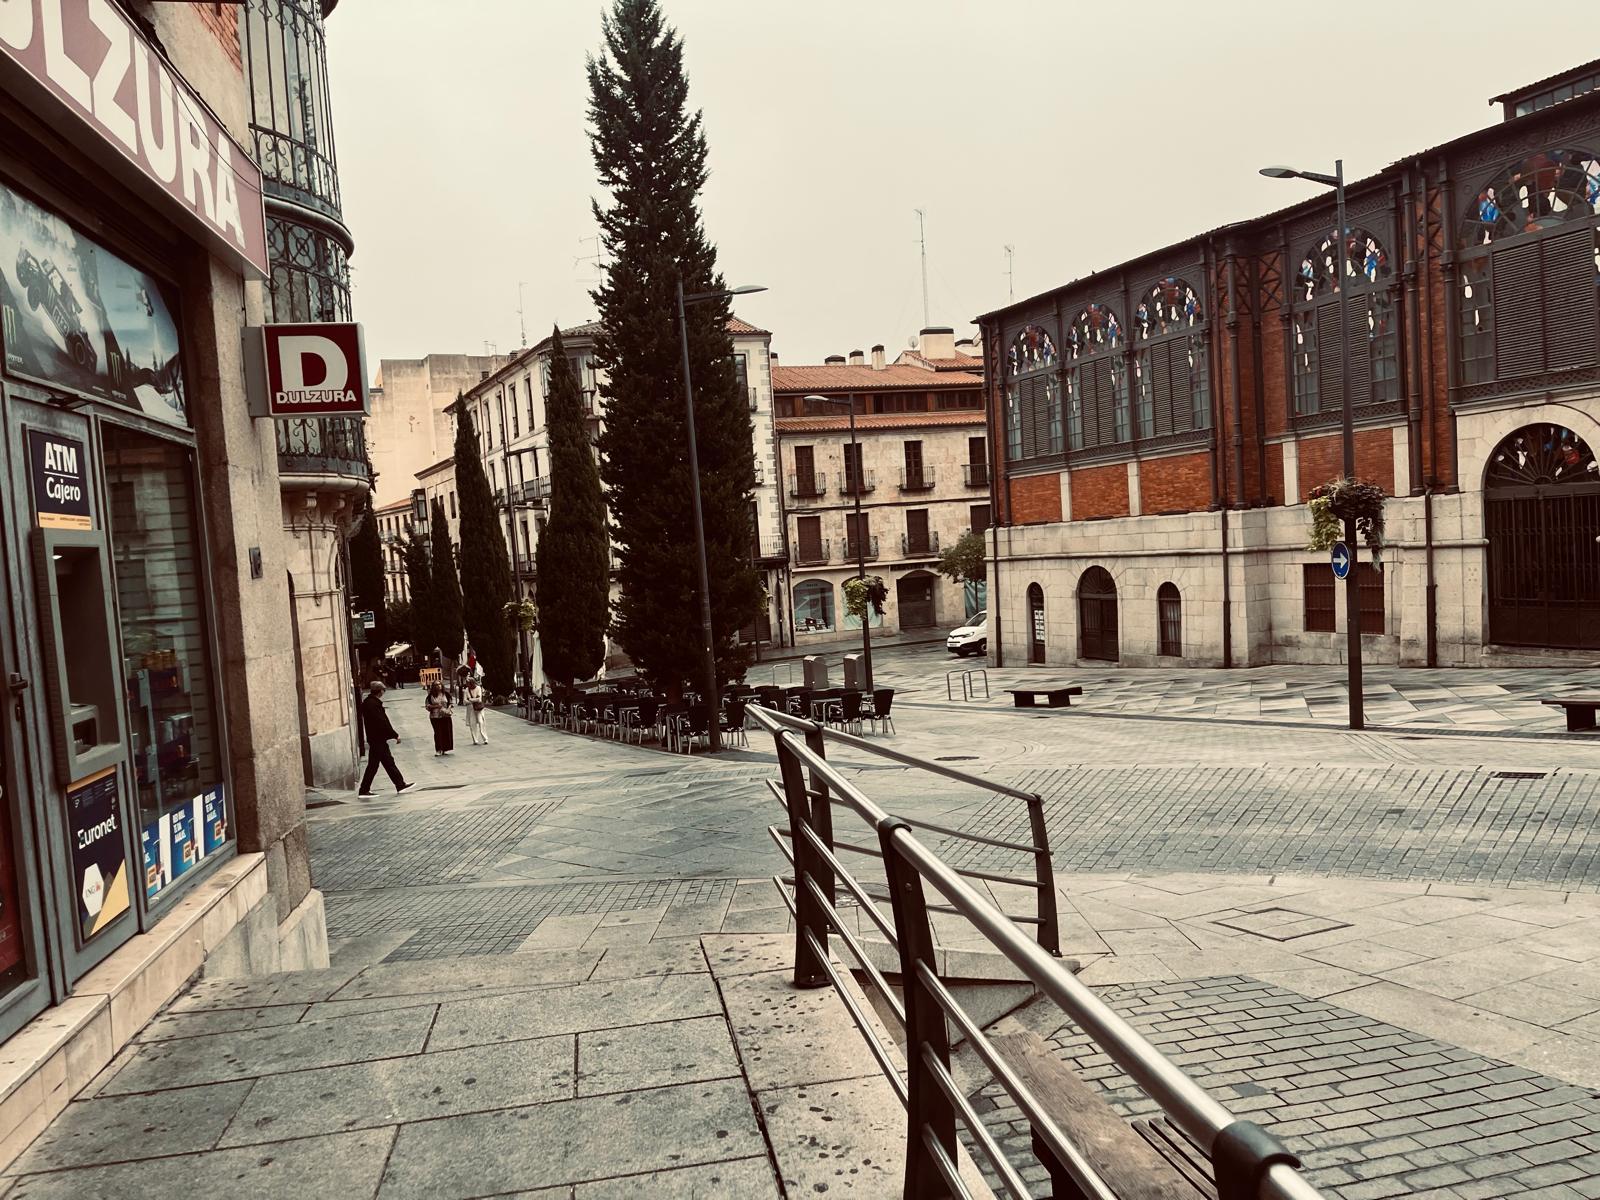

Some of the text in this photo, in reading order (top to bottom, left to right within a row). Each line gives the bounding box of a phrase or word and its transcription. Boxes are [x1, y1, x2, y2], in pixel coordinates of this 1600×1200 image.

[277, 335, 349, 391] D
[275, 389, 357, 404] DULZURA
[45, 441, 78, 474] ATM
[46, 476, 81, 504] Cajero
[77, 813, 118, 850] Euronet
